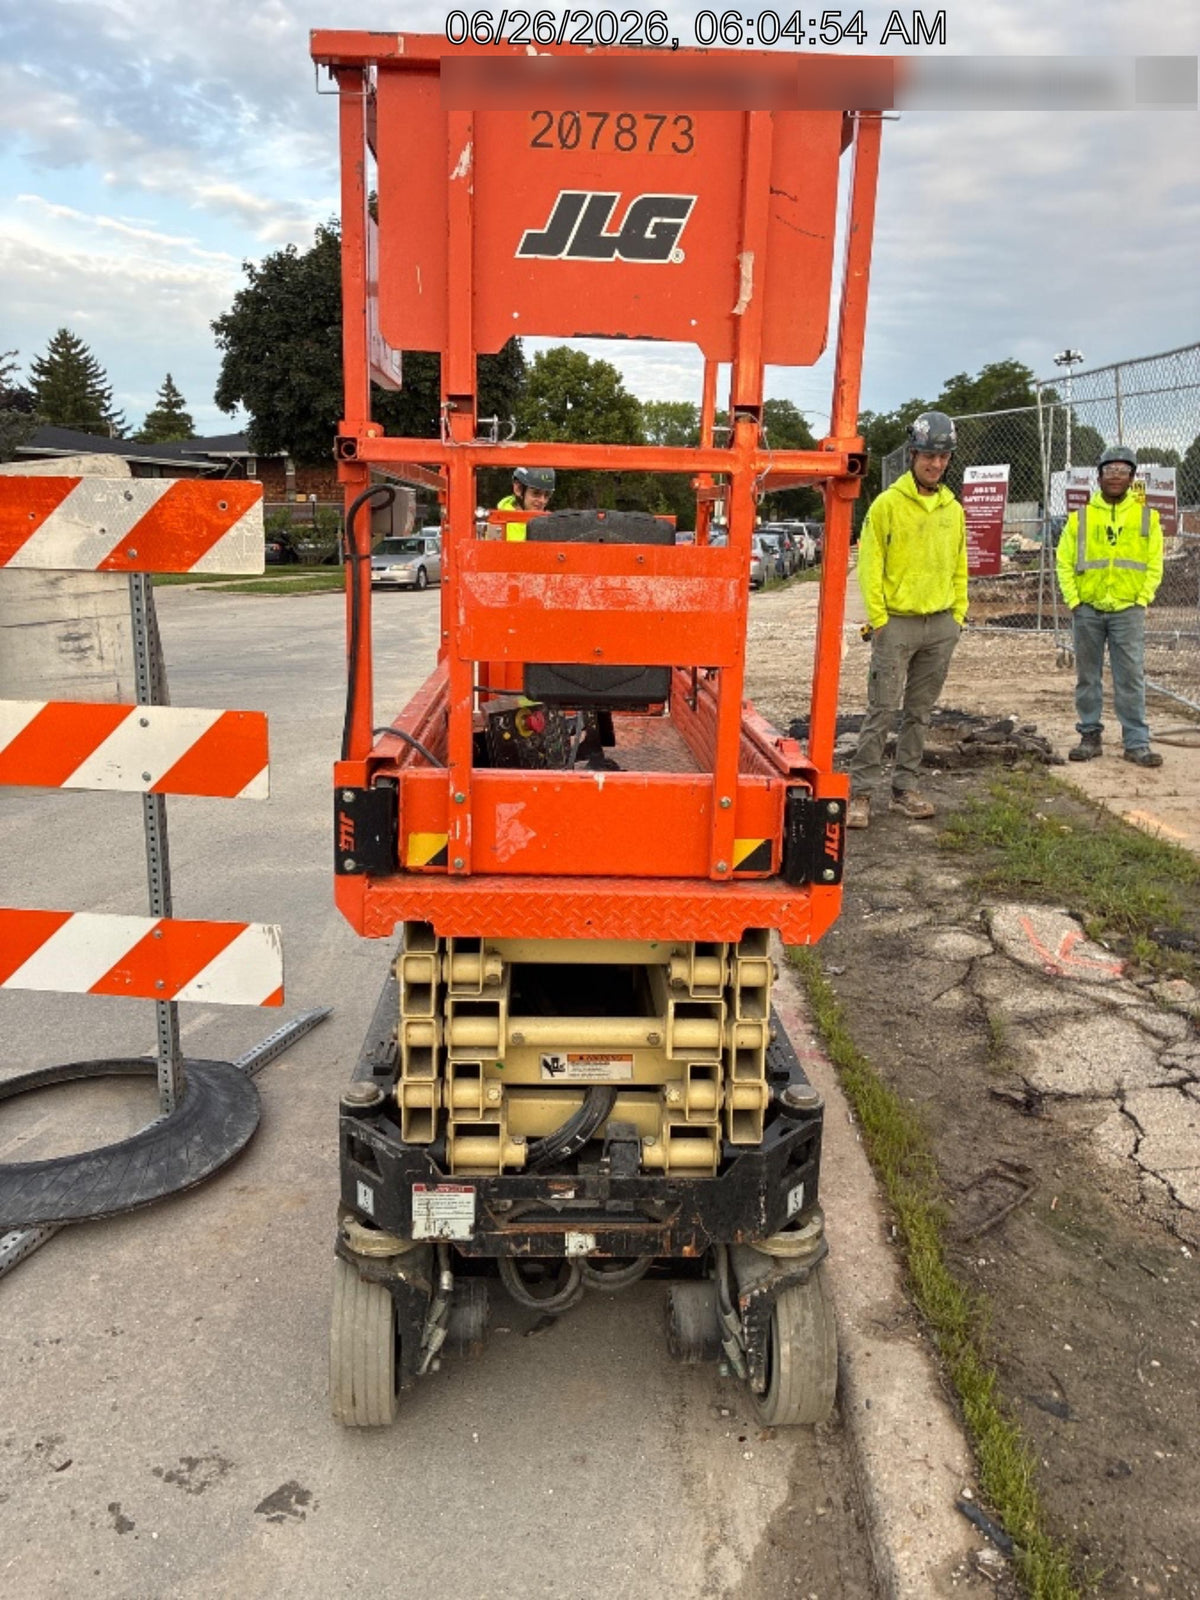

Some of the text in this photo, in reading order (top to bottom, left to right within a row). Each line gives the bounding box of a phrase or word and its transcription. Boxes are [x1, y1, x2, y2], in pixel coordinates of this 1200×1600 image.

[530, 110, 695, 154] 207873
[339, 810, 355, 852] JLG
[824, 821, 840, 863] JLG
